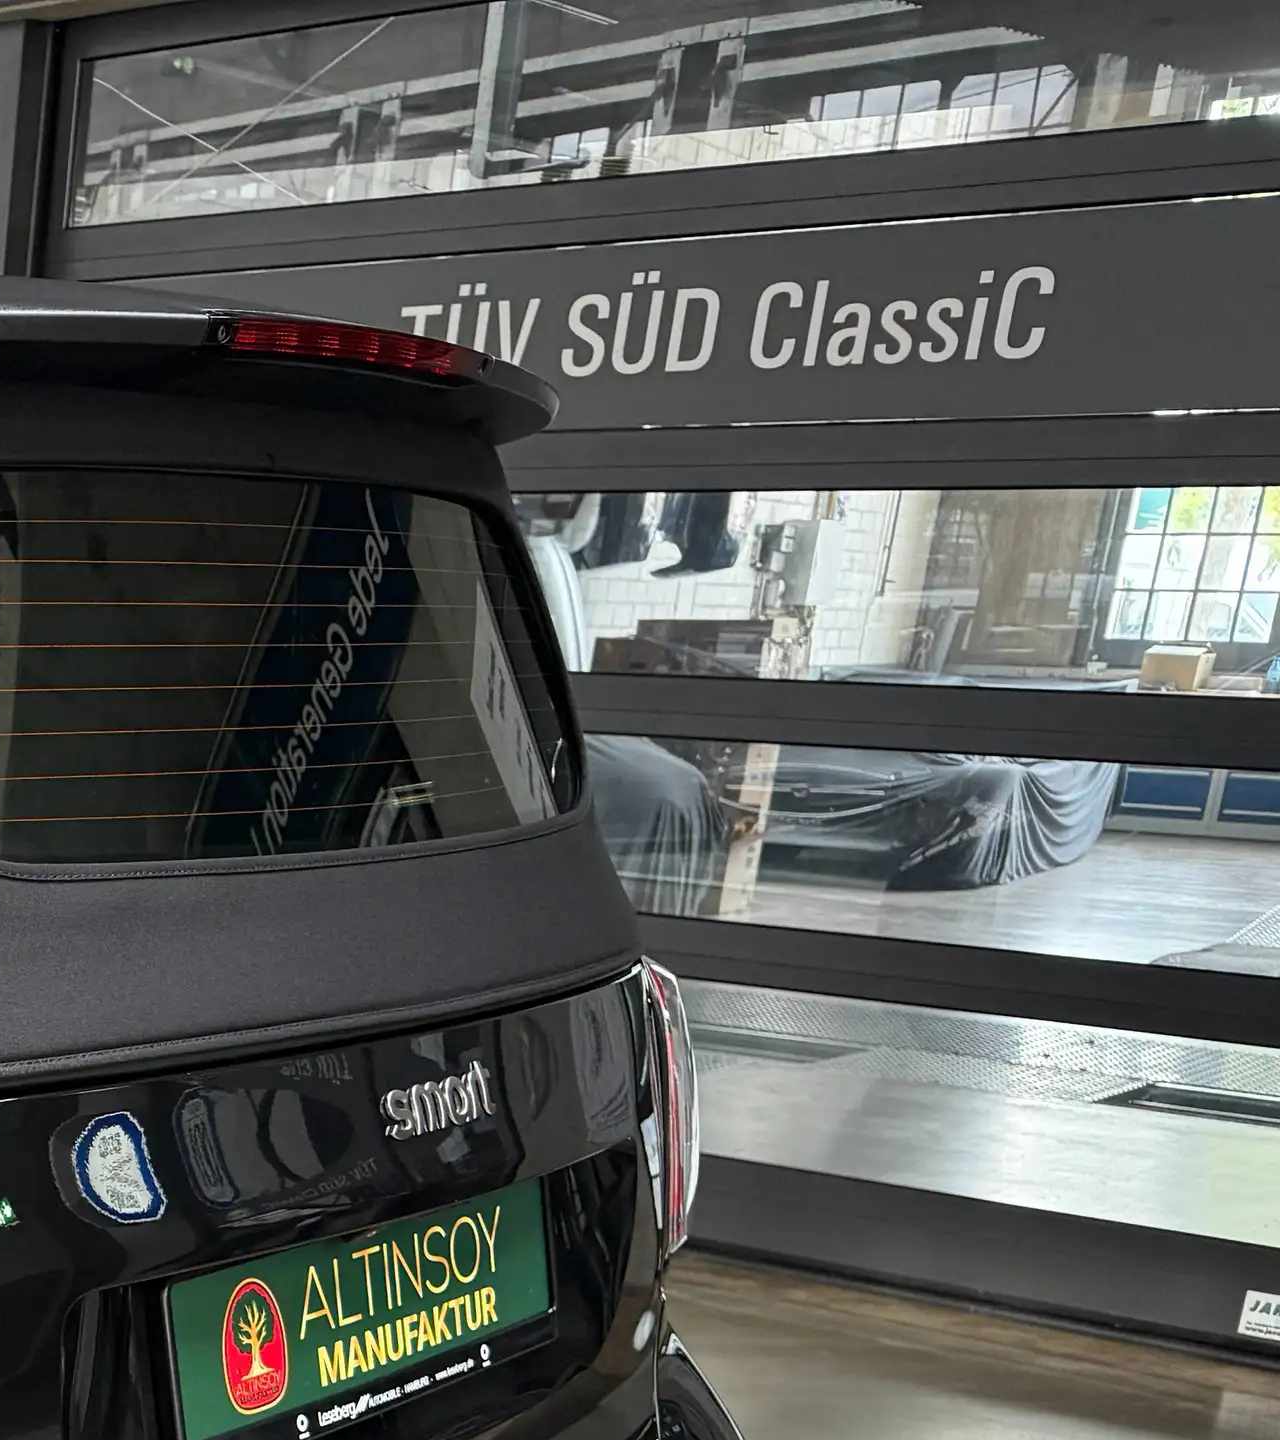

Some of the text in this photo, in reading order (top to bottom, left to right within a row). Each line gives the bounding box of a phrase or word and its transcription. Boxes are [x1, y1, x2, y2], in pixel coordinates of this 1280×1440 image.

[560, 270, 720, 378] SÜD
[748, 265, 1055, 370] ClassiC
[380, 1060, 497, 1141] smart
[299, 1205, 501, 1340] ALTINSOY
[317, 1286, 499, 1388] MANUFAKTUR
[317, 1400, 356, 1427] Leseberg
